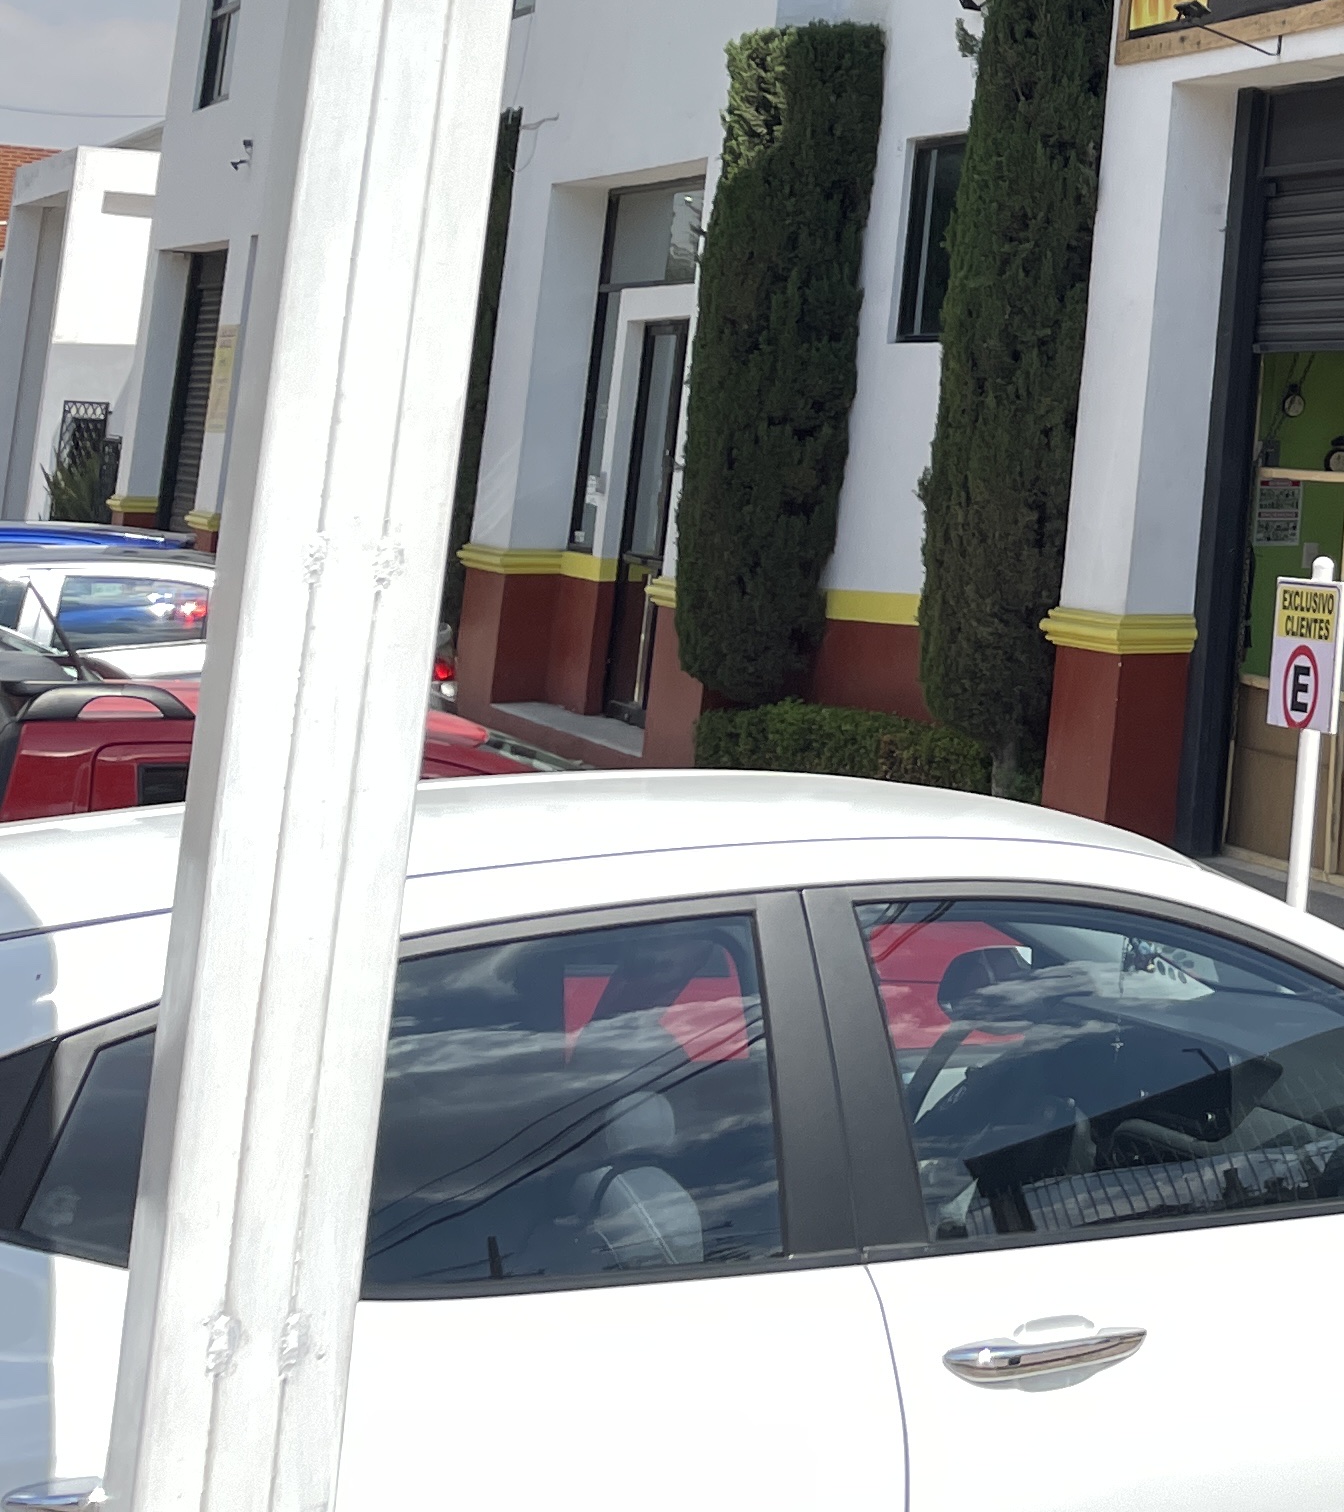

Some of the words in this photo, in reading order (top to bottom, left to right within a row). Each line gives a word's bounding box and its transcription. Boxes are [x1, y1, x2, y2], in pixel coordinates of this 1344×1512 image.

[1282, 589, 1334, 615] EXCLUSIVO
[1285, 615, 1330, 640] CLIENTES
[1291, 664, 1311, 713] E
